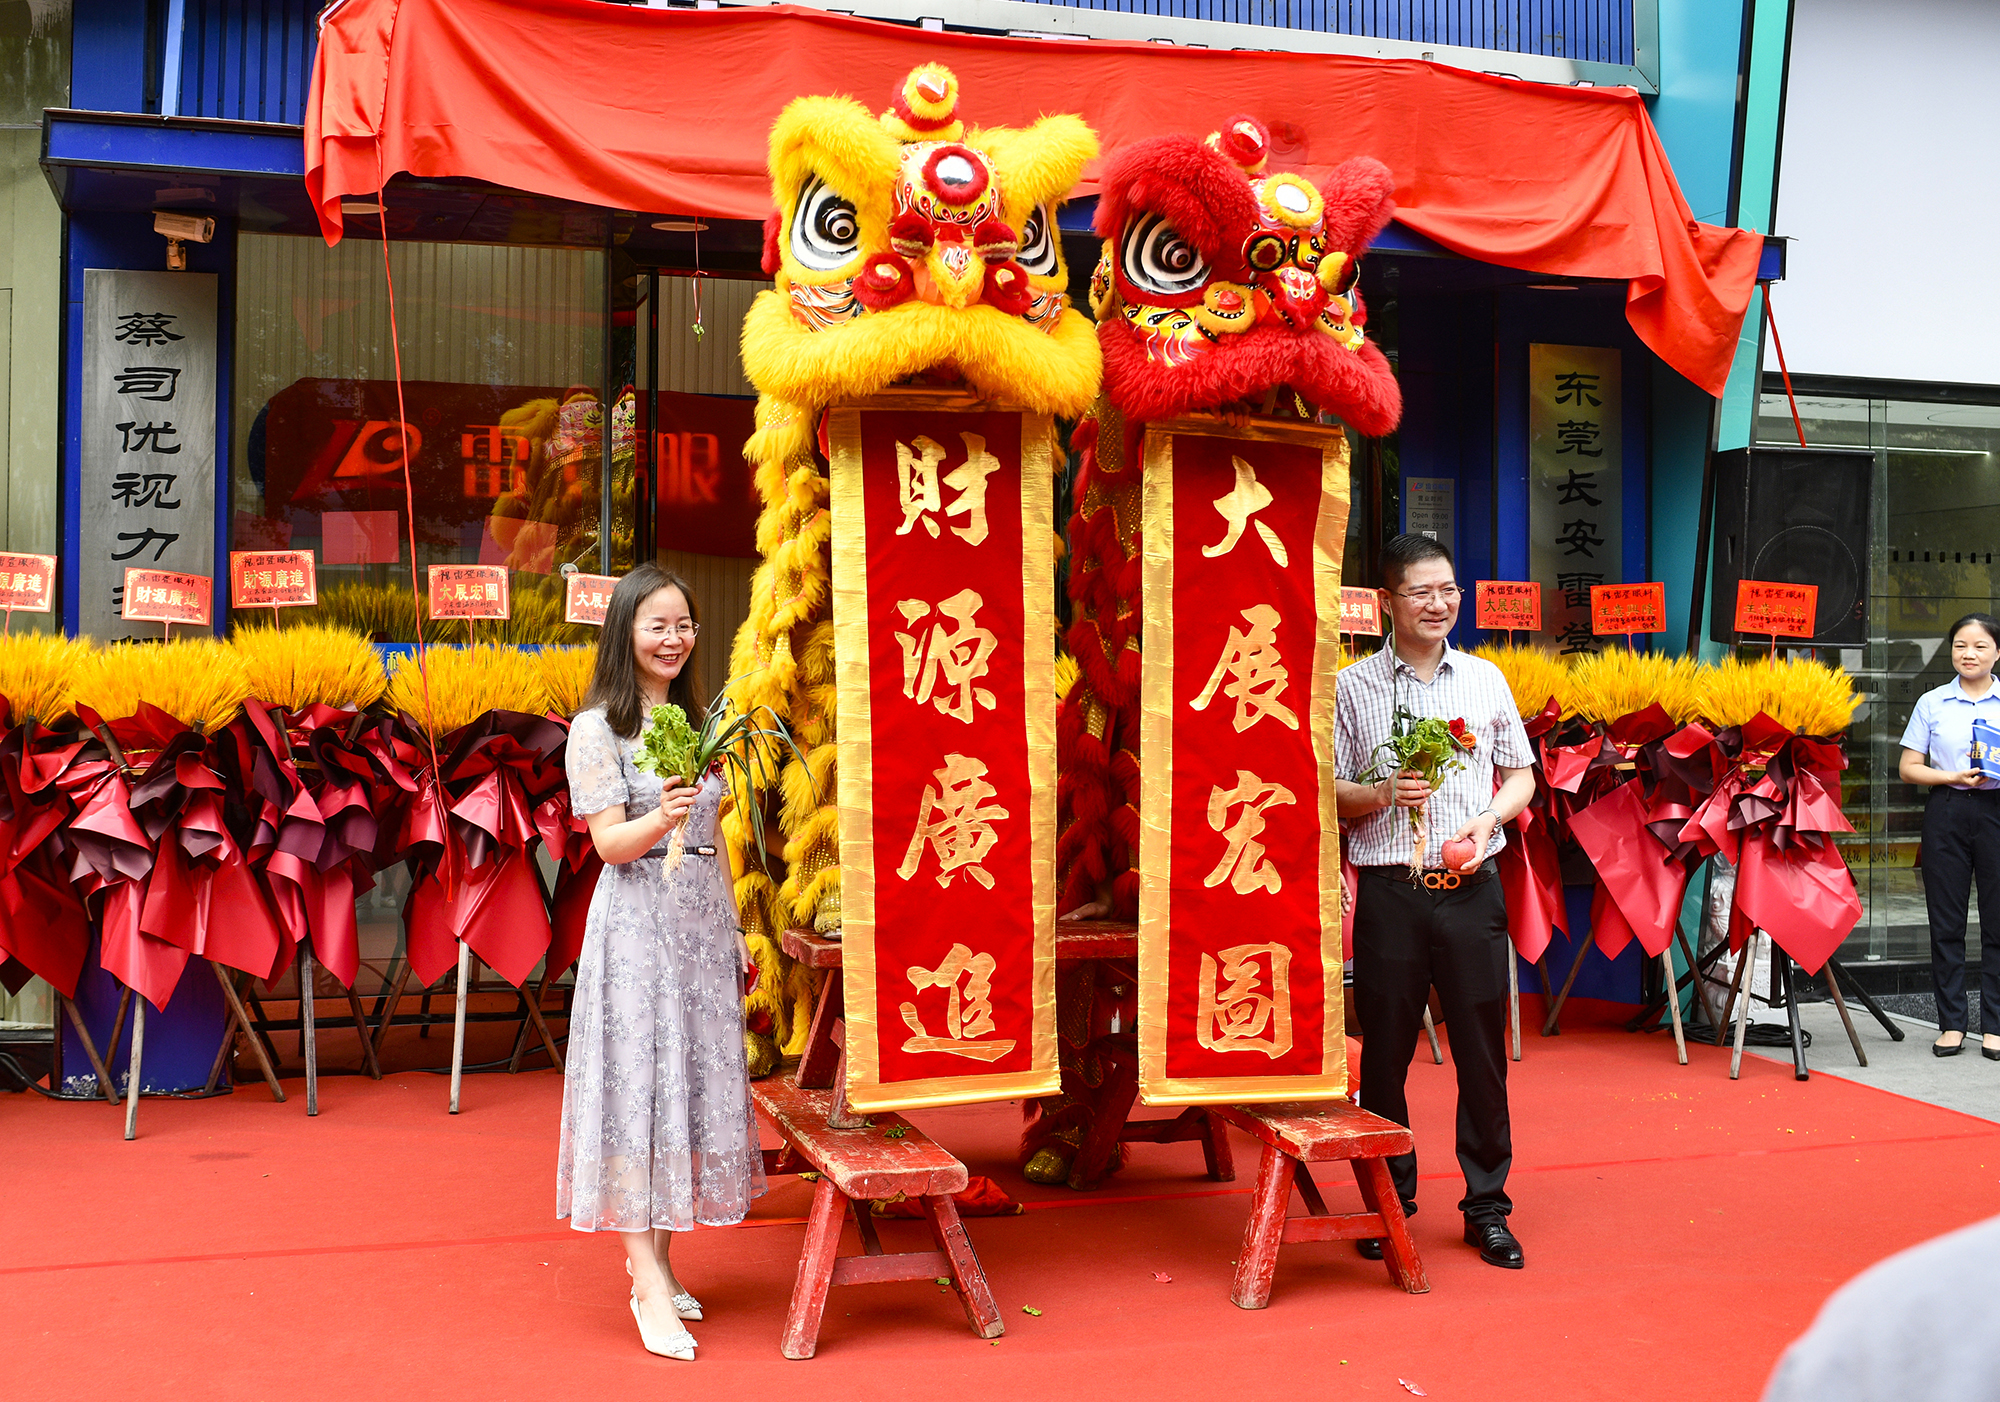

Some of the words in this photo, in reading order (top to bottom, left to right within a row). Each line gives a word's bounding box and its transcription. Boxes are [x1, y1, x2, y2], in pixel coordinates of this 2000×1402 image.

[111, 312, 187, 644] 蔡司优视力
[1411, 511, 1429, 519] Open
[1411, 521, 1429, 529] Close
[243, 568, 306, 590] 財源廣進
[134, 585, 200, 608] 財源廣進
[438, 583, 499, 602] 大展宏圖
[1484, 598, 1533, 613] 大展宏圖
[1598, 603, 1657, 618] 生意興隆
[1743, 602, 1806, 619] 生意興隆
[895, 431, 1016, 1062] 財源廣進
[1189, 455, 1299, 1059] 大展宏圖
